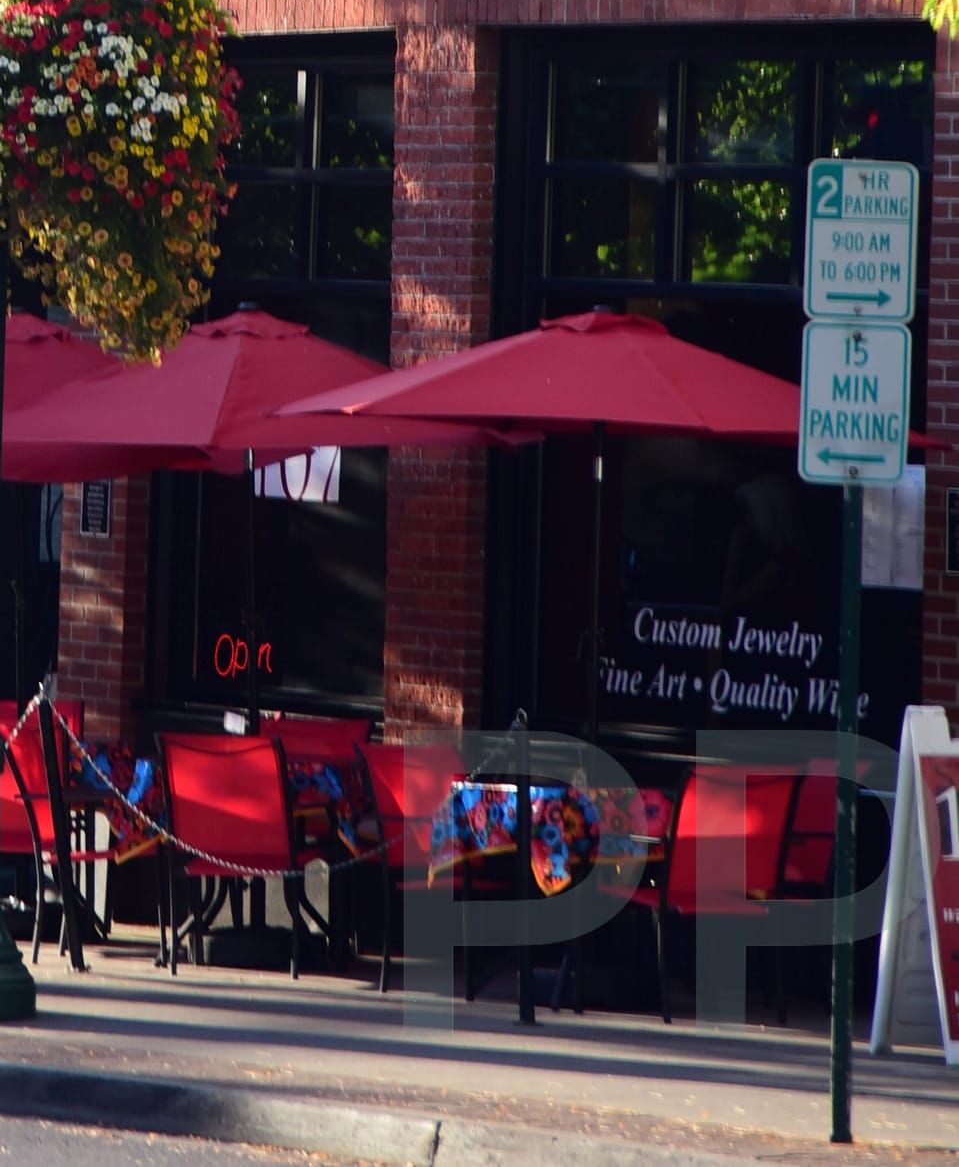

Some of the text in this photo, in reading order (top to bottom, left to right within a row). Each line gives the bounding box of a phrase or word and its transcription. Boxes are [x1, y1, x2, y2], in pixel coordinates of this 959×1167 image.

[816, 171, 889, 216] 2 HR
[844, 196, 909, 217] PARKING
[832, 230, 891, 252] 9:00 AM
[819, 260, 901, 282] TO 6:00 PM
[845, 337, 869, 367] 15
[832, 375, 878, 404] MIN
[809, 409, 899, 443] PARKING
[634, 607, 823, 668] Custom Jewelry
[215, 634, 272, 678] Opn
[647, 663, 687, 700] Art
[710, 668, 799, 721] Quality
[808, 676, 869, 718] Wie
